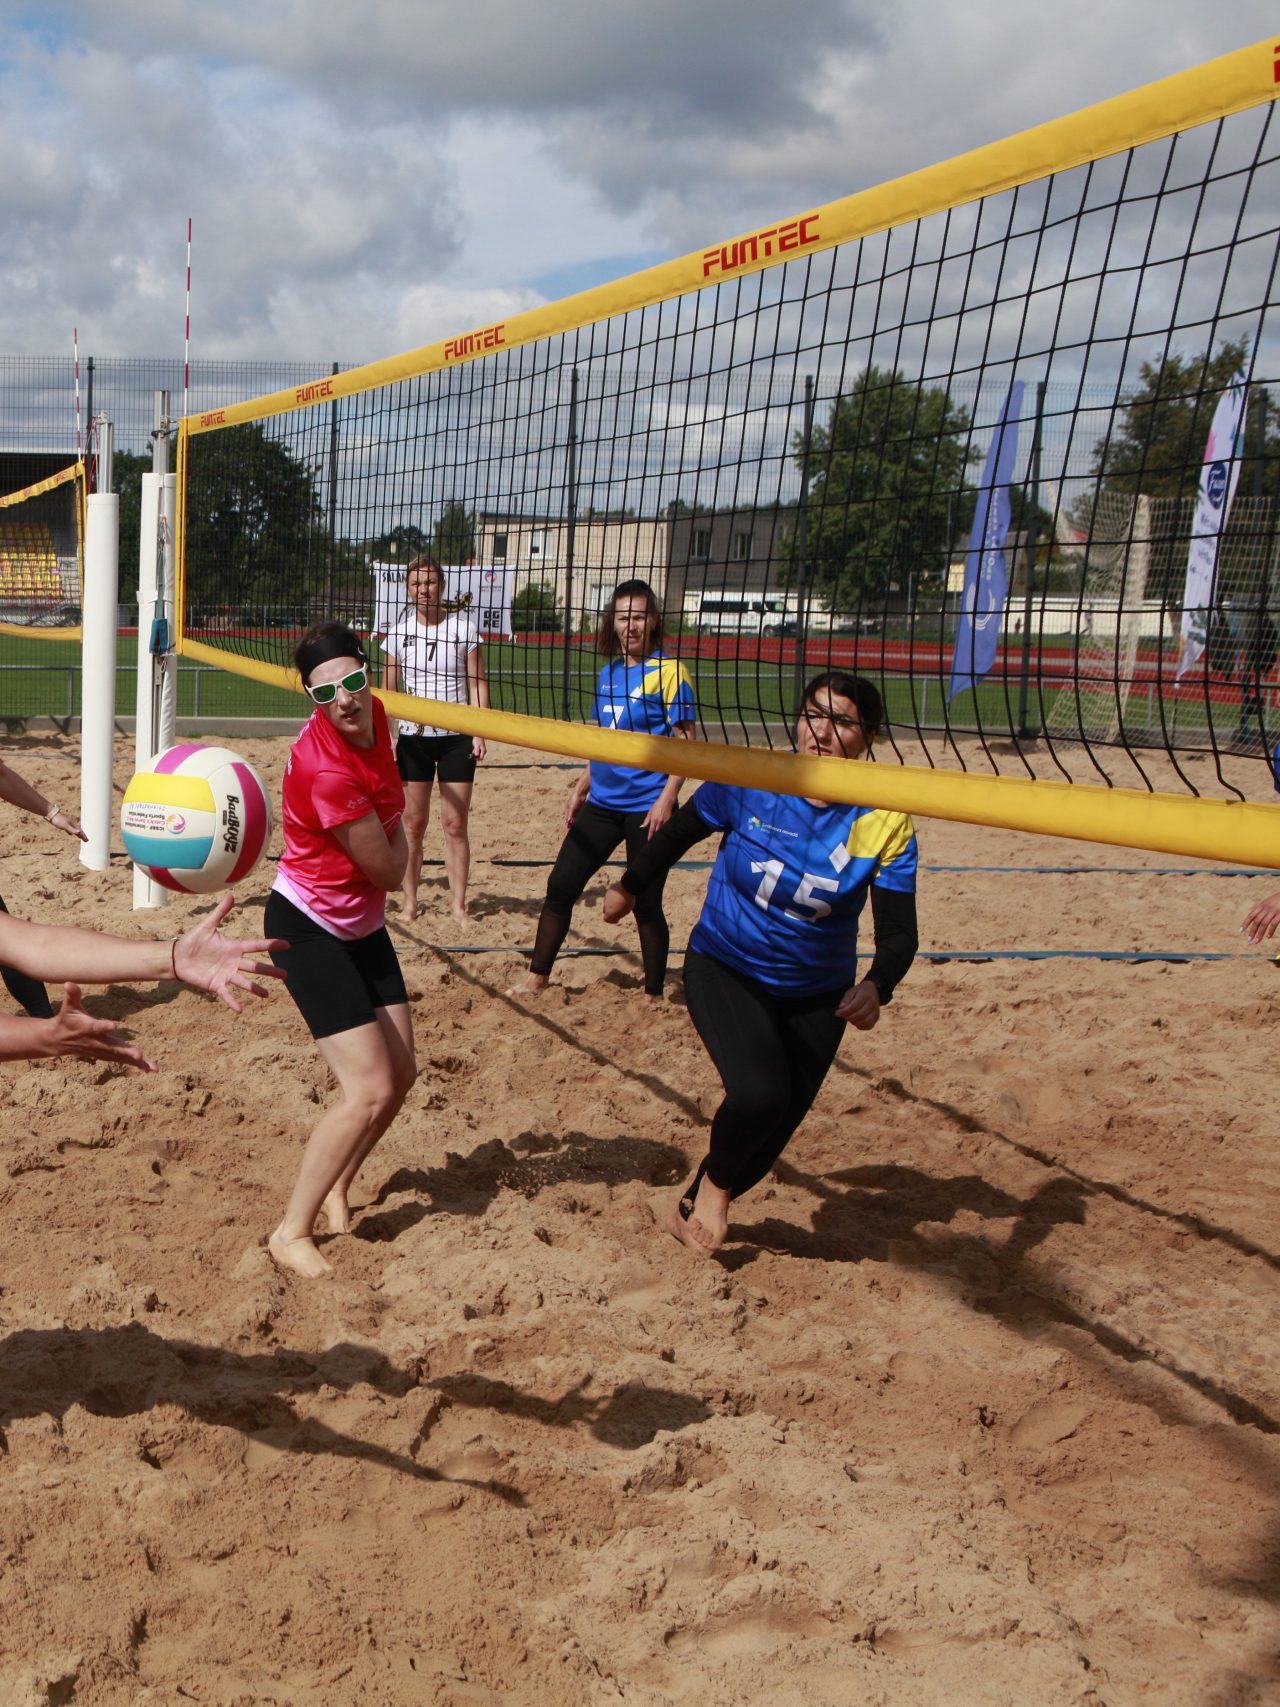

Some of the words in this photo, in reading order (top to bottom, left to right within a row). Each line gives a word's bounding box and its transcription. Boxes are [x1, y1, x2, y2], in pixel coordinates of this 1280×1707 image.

[703, 214, 820, 277] FUNTEC
[444, 324, 506, 361] FUNTEC
[296, 380, 334, 404] FUNTEC
[200, 411, 226, 428] FUNTEC
[426, 642, 437, 662] 7
[602, 704, 625, 730] 7
[750, 858, 840, 924] 15
